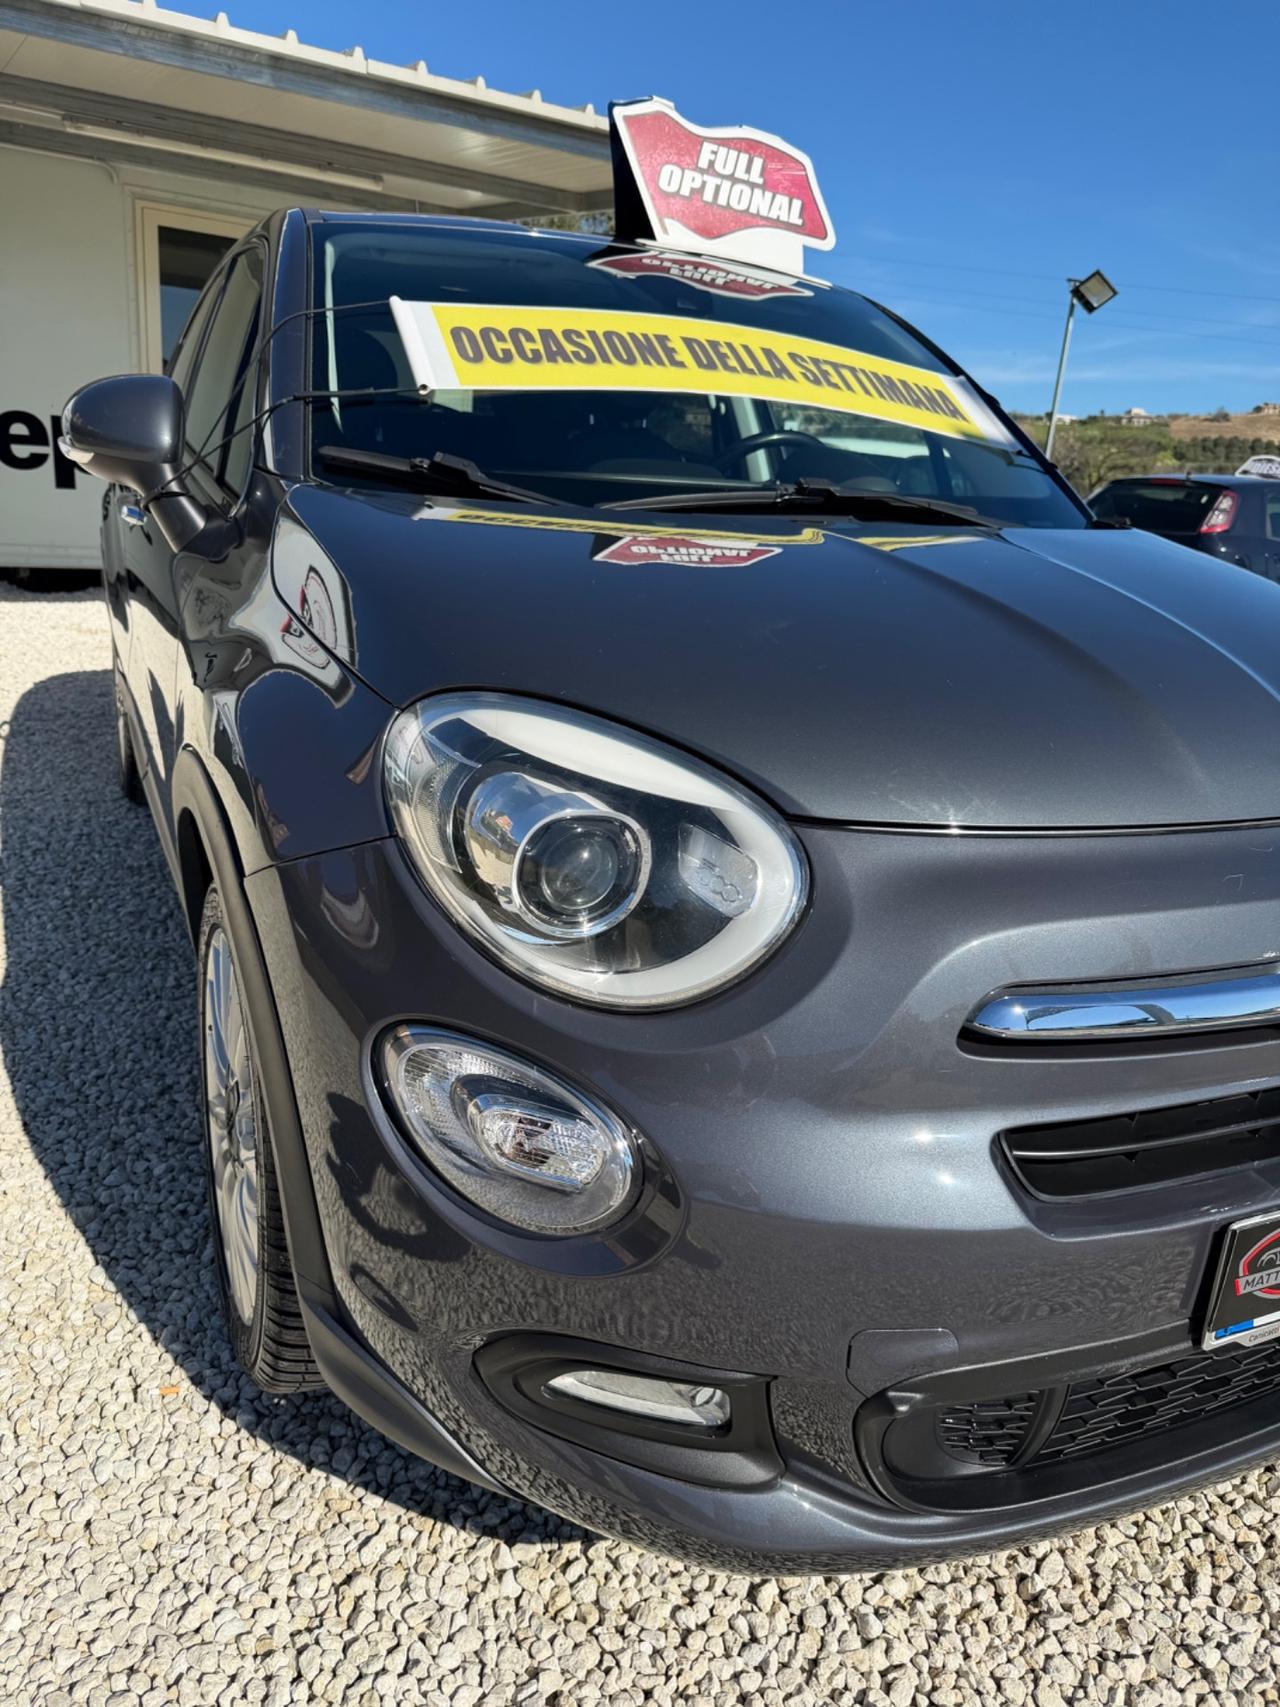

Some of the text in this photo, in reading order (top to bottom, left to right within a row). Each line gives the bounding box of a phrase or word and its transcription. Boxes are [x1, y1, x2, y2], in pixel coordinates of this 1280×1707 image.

[697, 141, 765, 185] FULL
[658, 164, 803, 226] OPTIONAL
[449, 326, 968, 422] OCCASIONE DELLA SETTIMANA
